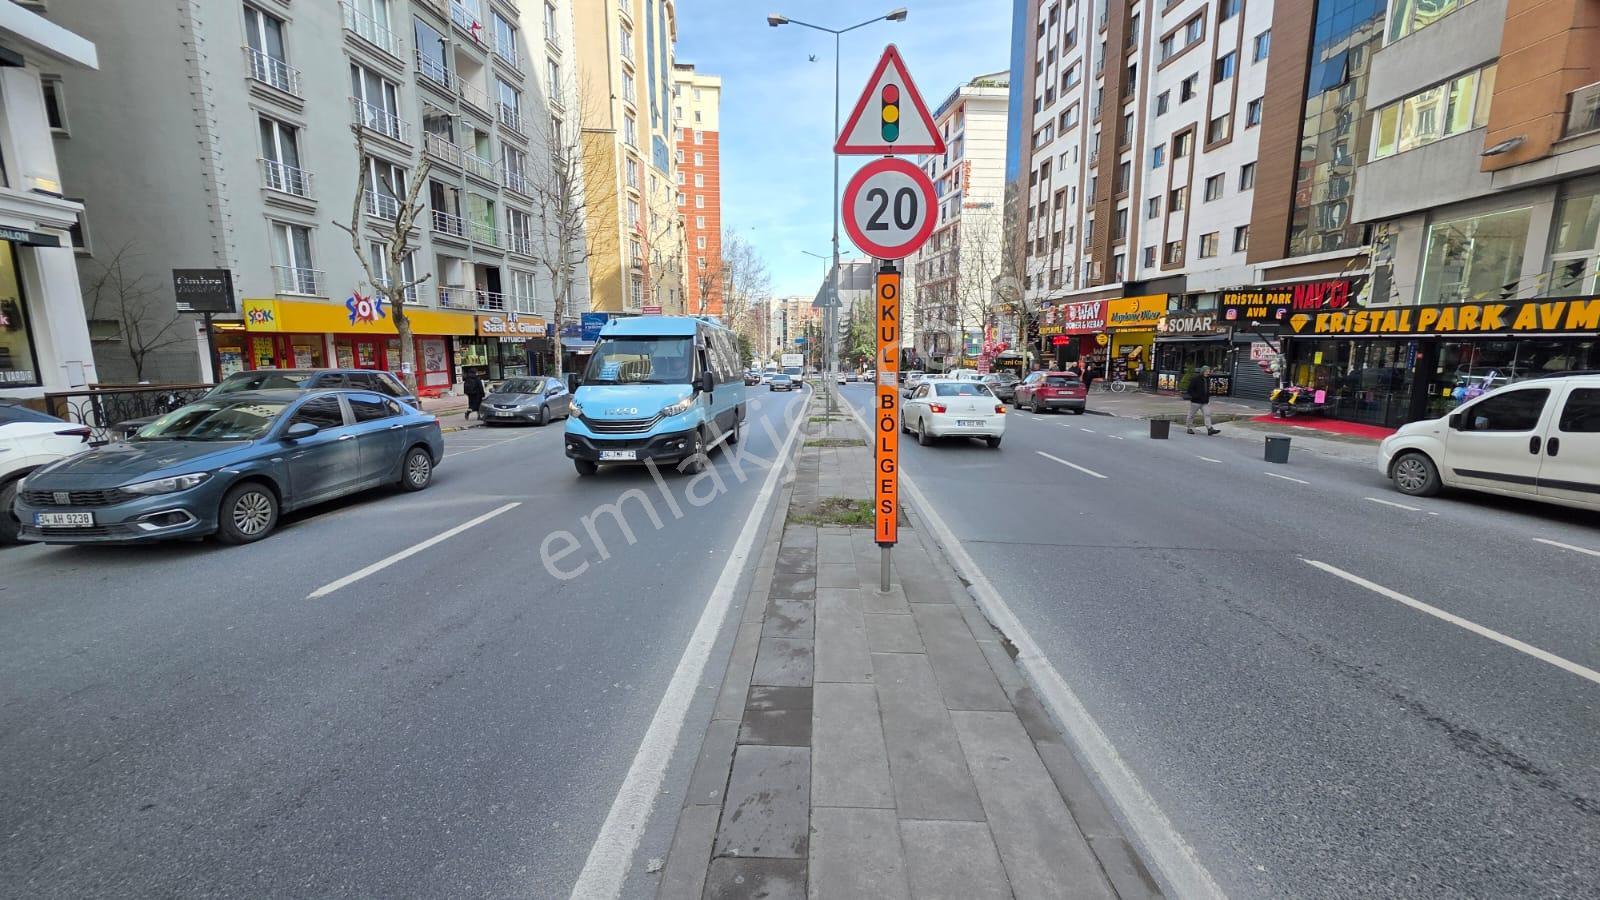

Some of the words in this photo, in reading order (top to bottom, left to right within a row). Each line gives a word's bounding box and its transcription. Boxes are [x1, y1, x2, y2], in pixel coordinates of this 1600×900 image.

[865, 186, 919, 231] 20
[1265, 293, 1292, 305] PARK
[1246, 307, 1268, 318] AVM
[1416, 304, 1510, 332] PARK
[1512, 299, 1600, 331] AVM
[483, 320, 507, 333] Saat
[508, 322, 516, 333] &
[881, 283, 897, 363] OKUL
[1168, 317, 1212, 332] SOMAR
[39, 514, 49, 524] 34
[66, 513, 90, 524] 9238
